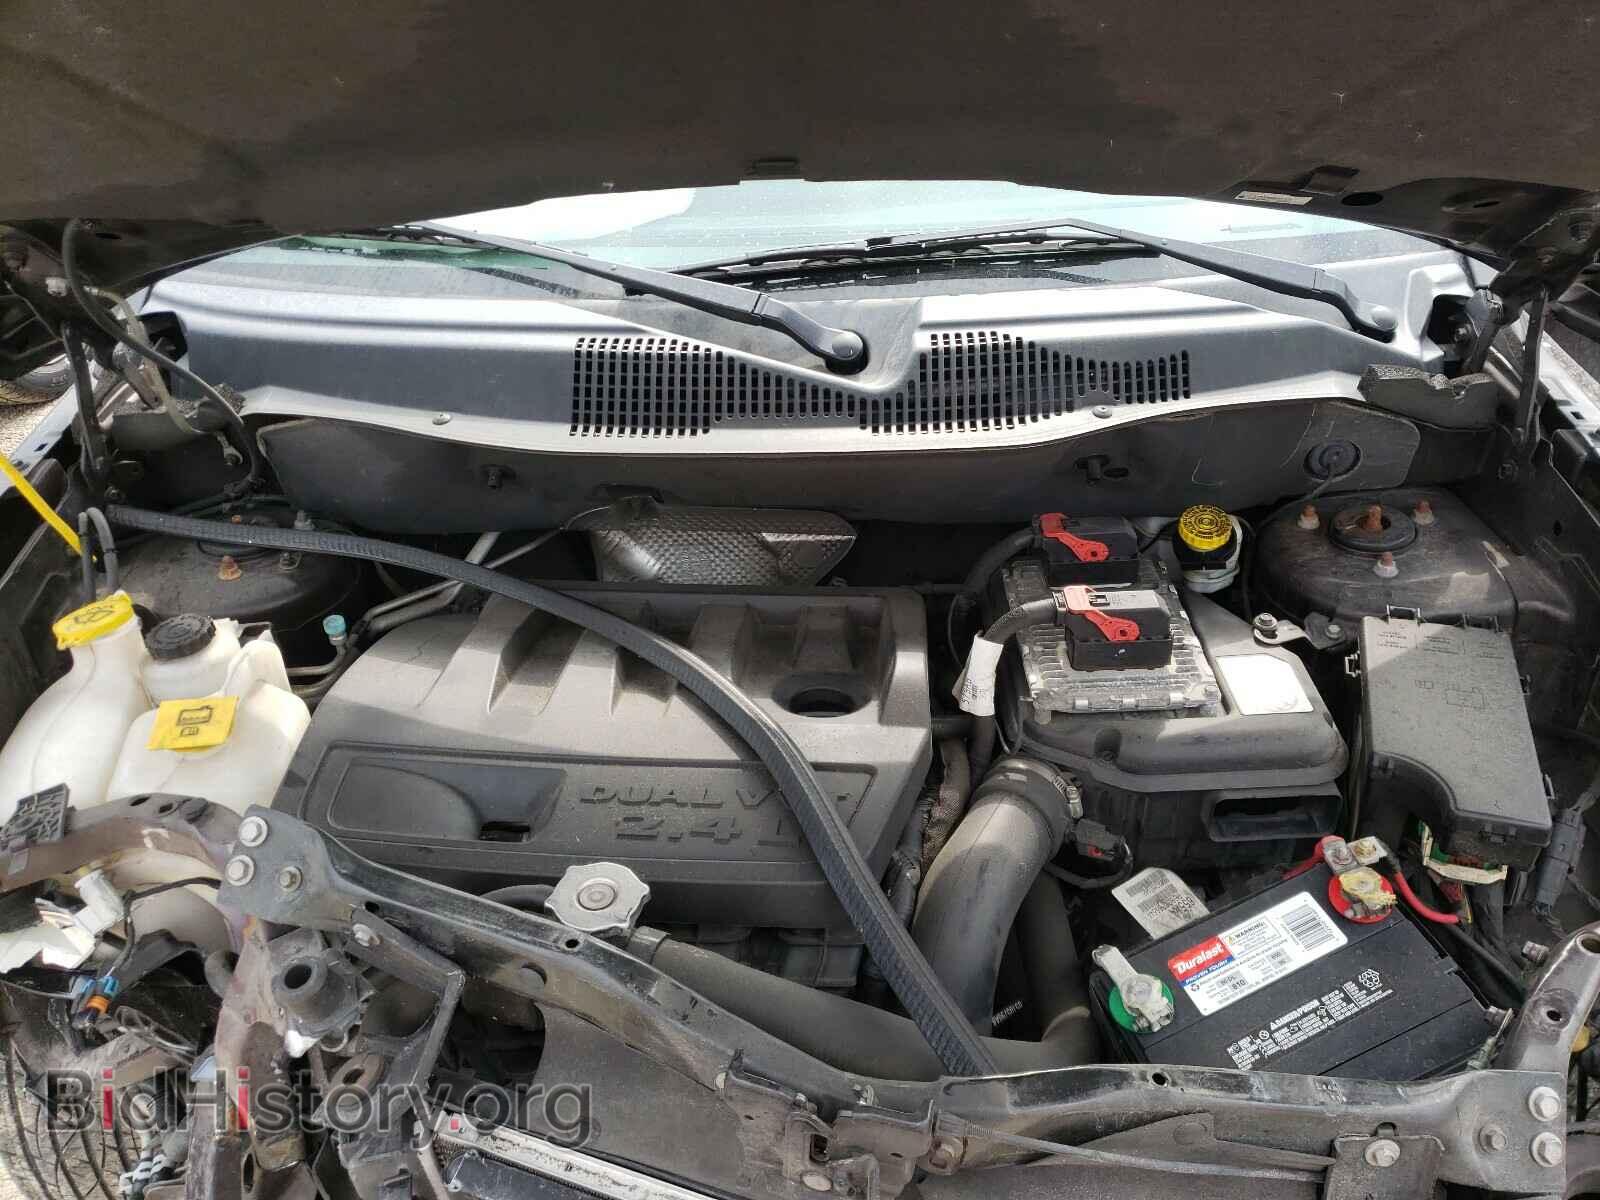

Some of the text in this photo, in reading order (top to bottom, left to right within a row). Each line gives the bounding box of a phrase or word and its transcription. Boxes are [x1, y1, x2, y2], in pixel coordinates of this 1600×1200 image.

[578, 782, 723, 809] DUAL
[1173, 942, 1225, 974] Duralast
[1232, 979, 1247, 991] 810
